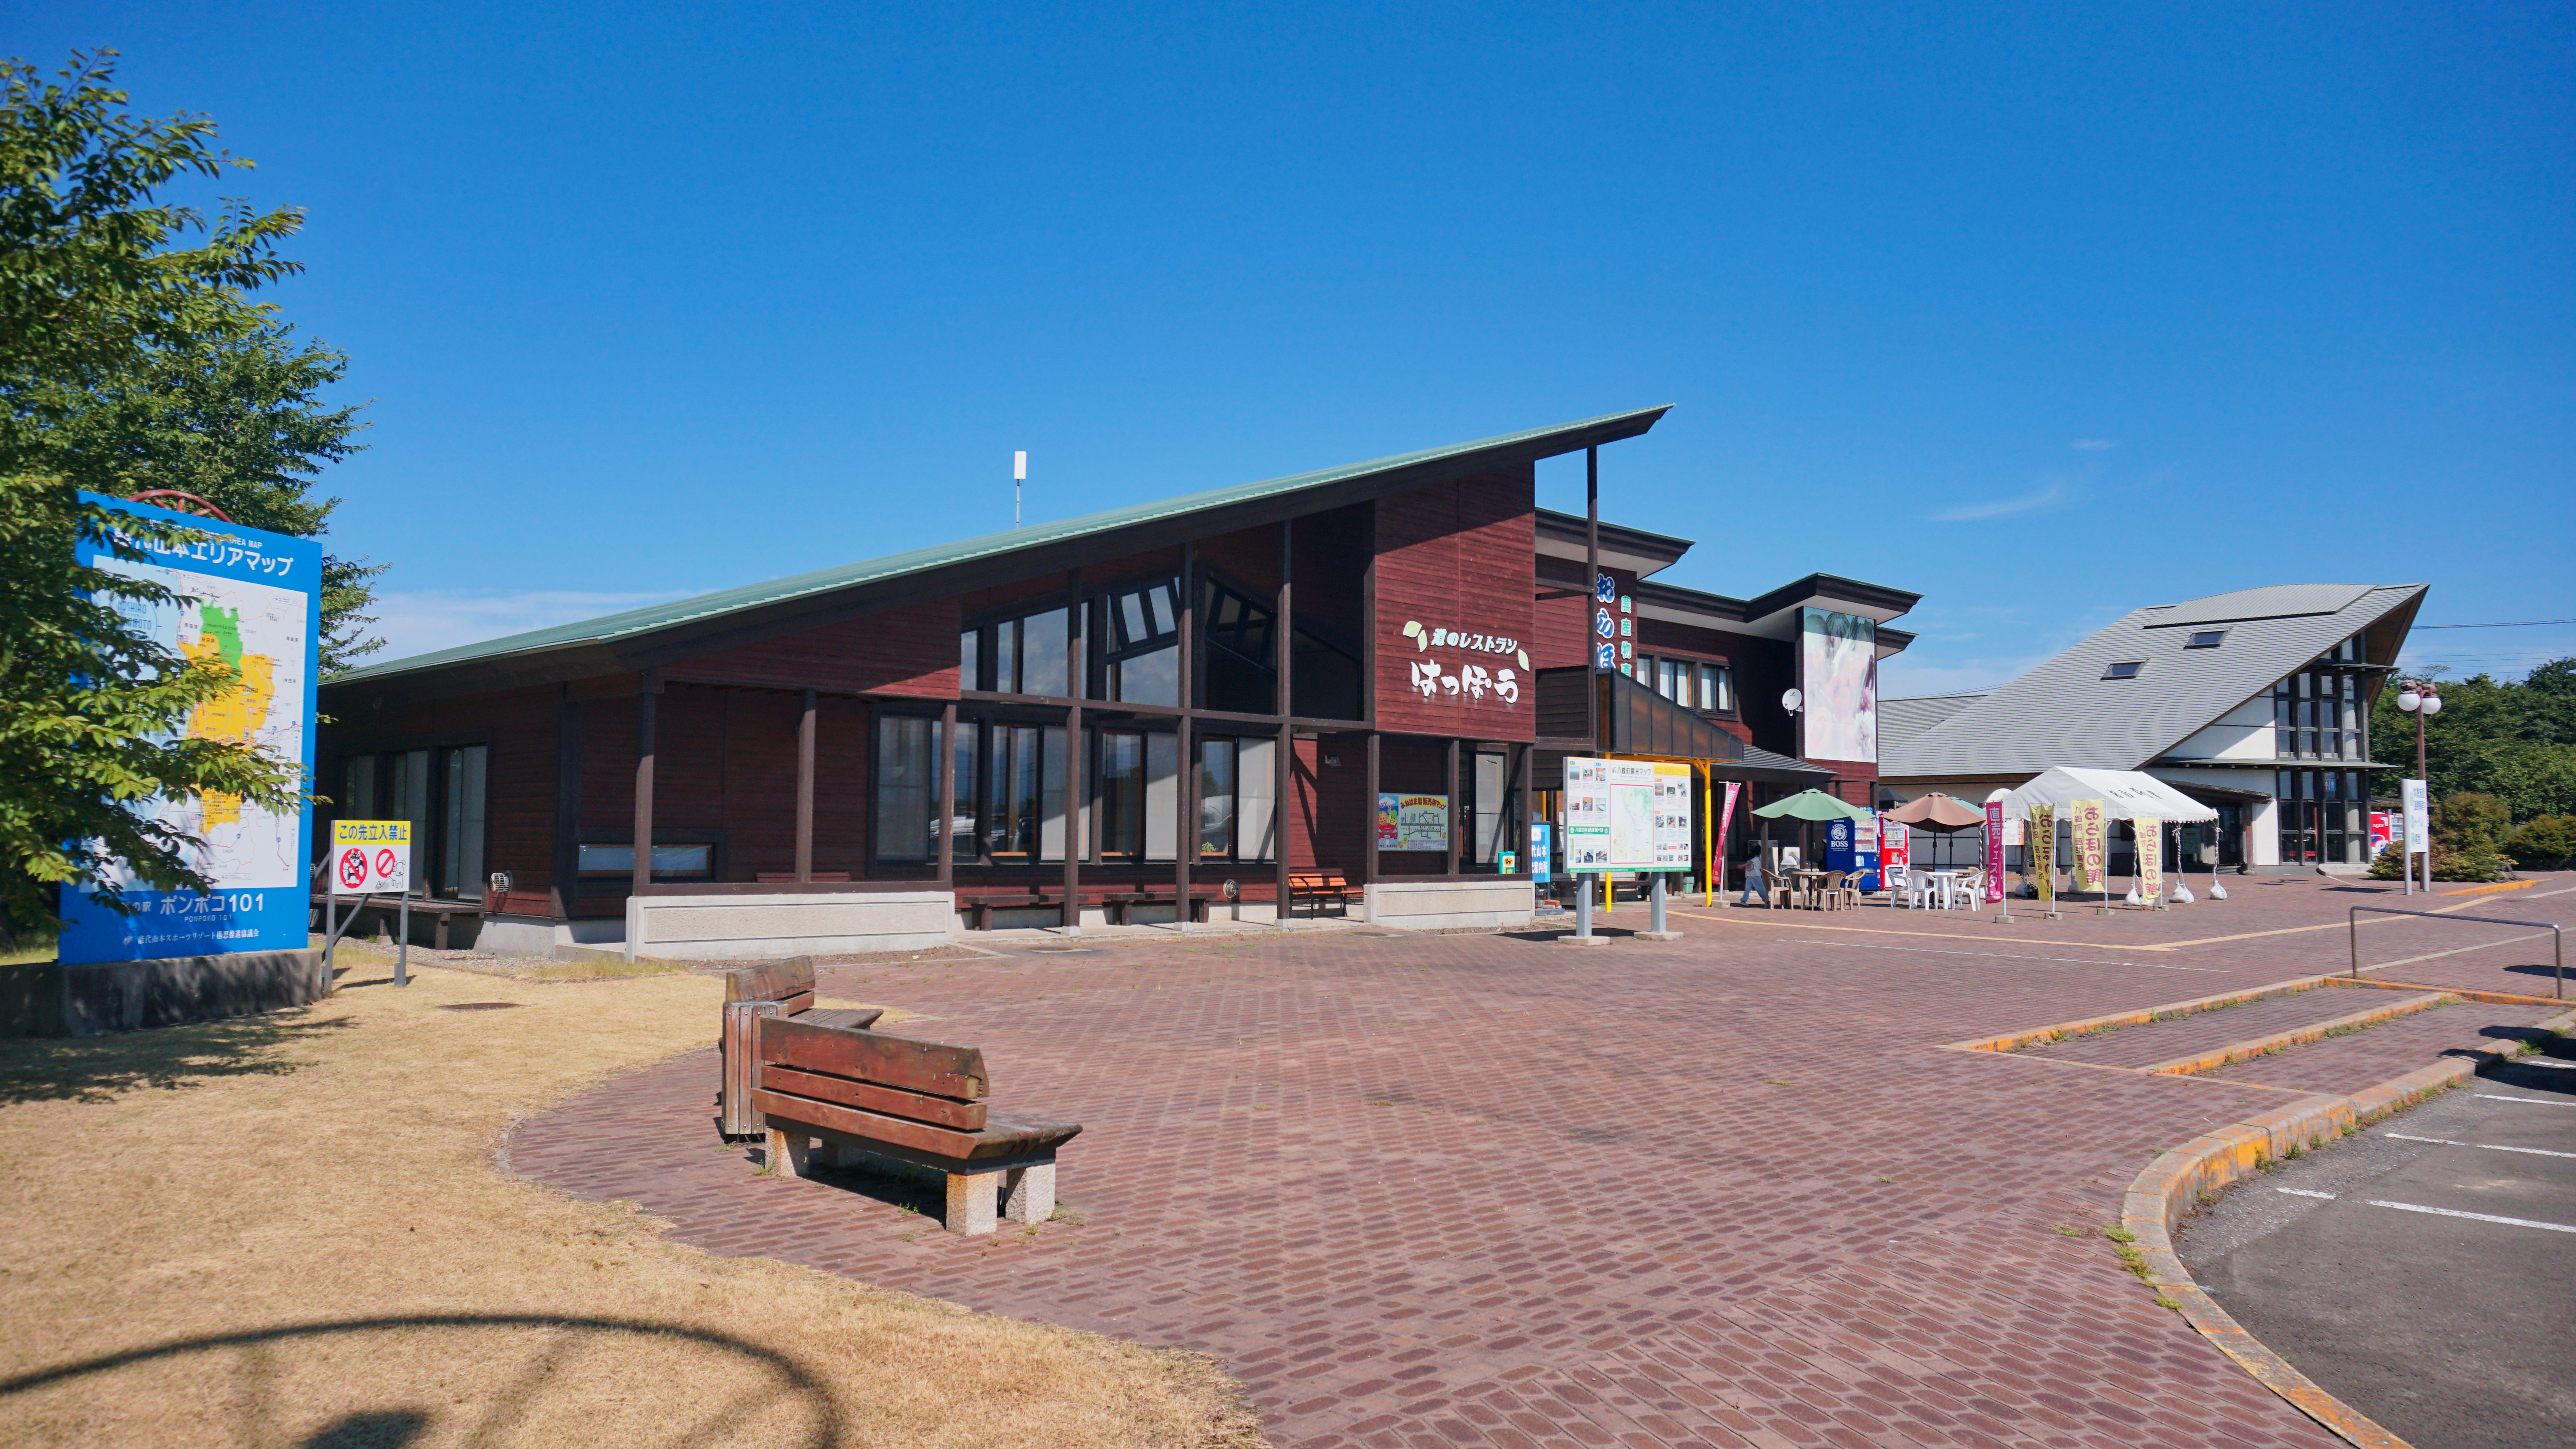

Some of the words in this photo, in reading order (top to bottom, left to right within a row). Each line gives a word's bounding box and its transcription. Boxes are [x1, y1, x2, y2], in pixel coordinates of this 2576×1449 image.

[248, 540, 263, 549] MAP
[1431, 628, 1518, 654] 道のレストラン
[1410, 659, 1519, 704] はっぽう
[339, 824, 407, 841] この先立入禁止
[1531, 844, 1547, 858] 代山本
[1989, 807, 2001, 887] 直売フェスタ
[129, 901, 152, 912] の駅
